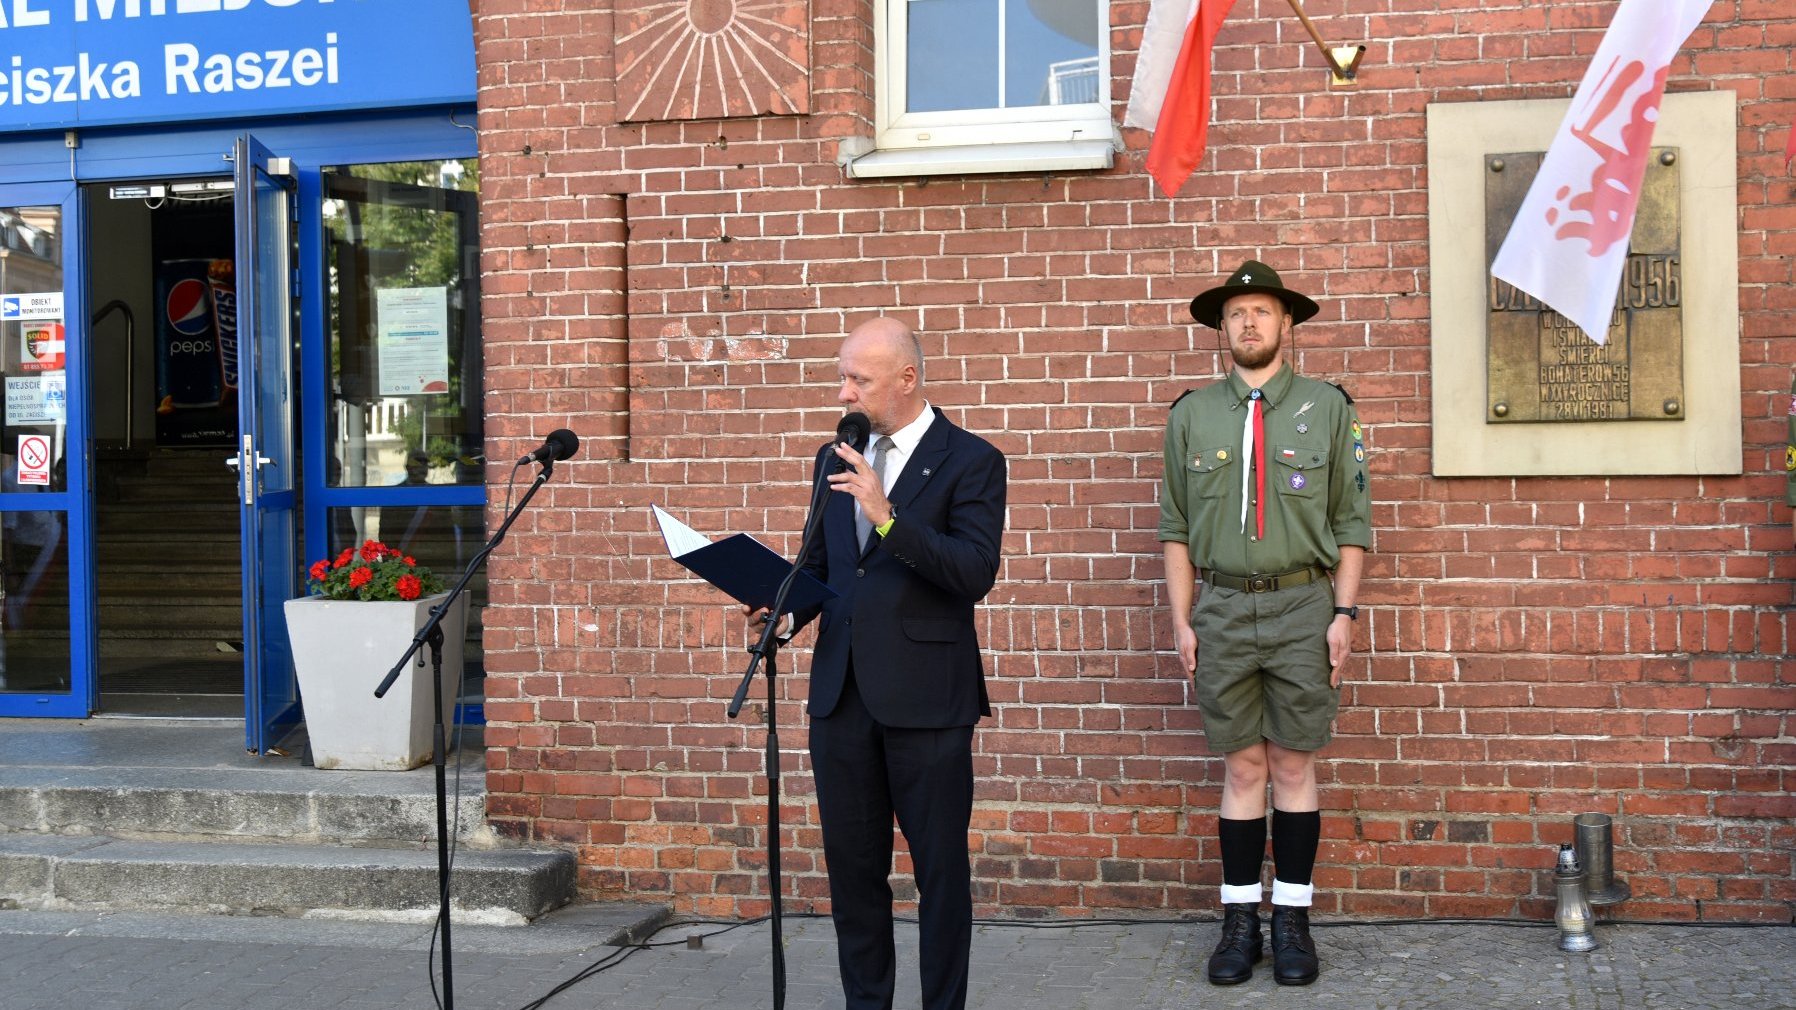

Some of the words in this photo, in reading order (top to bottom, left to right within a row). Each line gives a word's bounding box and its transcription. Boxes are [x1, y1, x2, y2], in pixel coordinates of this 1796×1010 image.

[164, 32, 339, 96] Raszei
[1623, 254, 1680, 309] 1956
[27, 331, 49, 340] SOLID
[214, 289, 238, 386] SNICKERS
